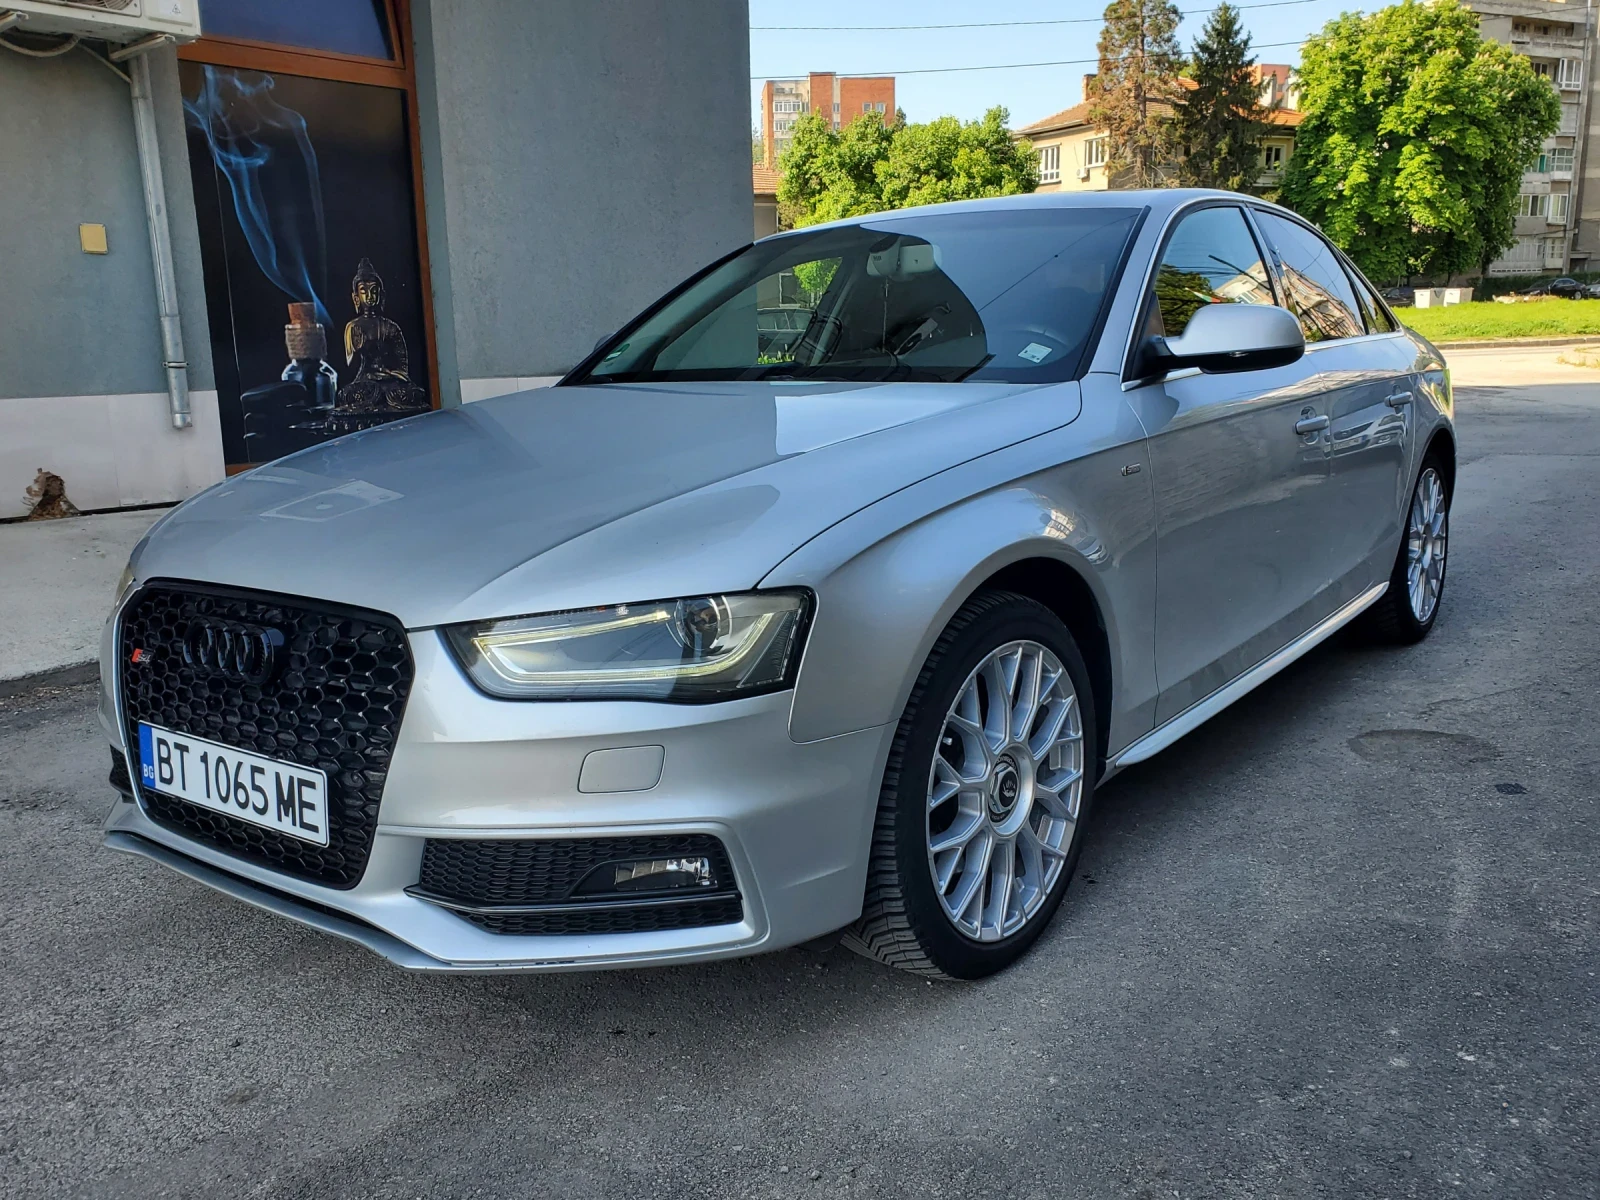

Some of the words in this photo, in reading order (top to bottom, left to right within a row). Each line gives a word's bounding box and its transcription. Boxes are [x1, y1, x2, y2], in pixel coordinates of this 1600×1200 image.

[143, 763, 154, 779] BG
[156, 737, 190, 791] BT
[200, 751, 269, 816] 1065
[275, 771, 319, 834] ME
